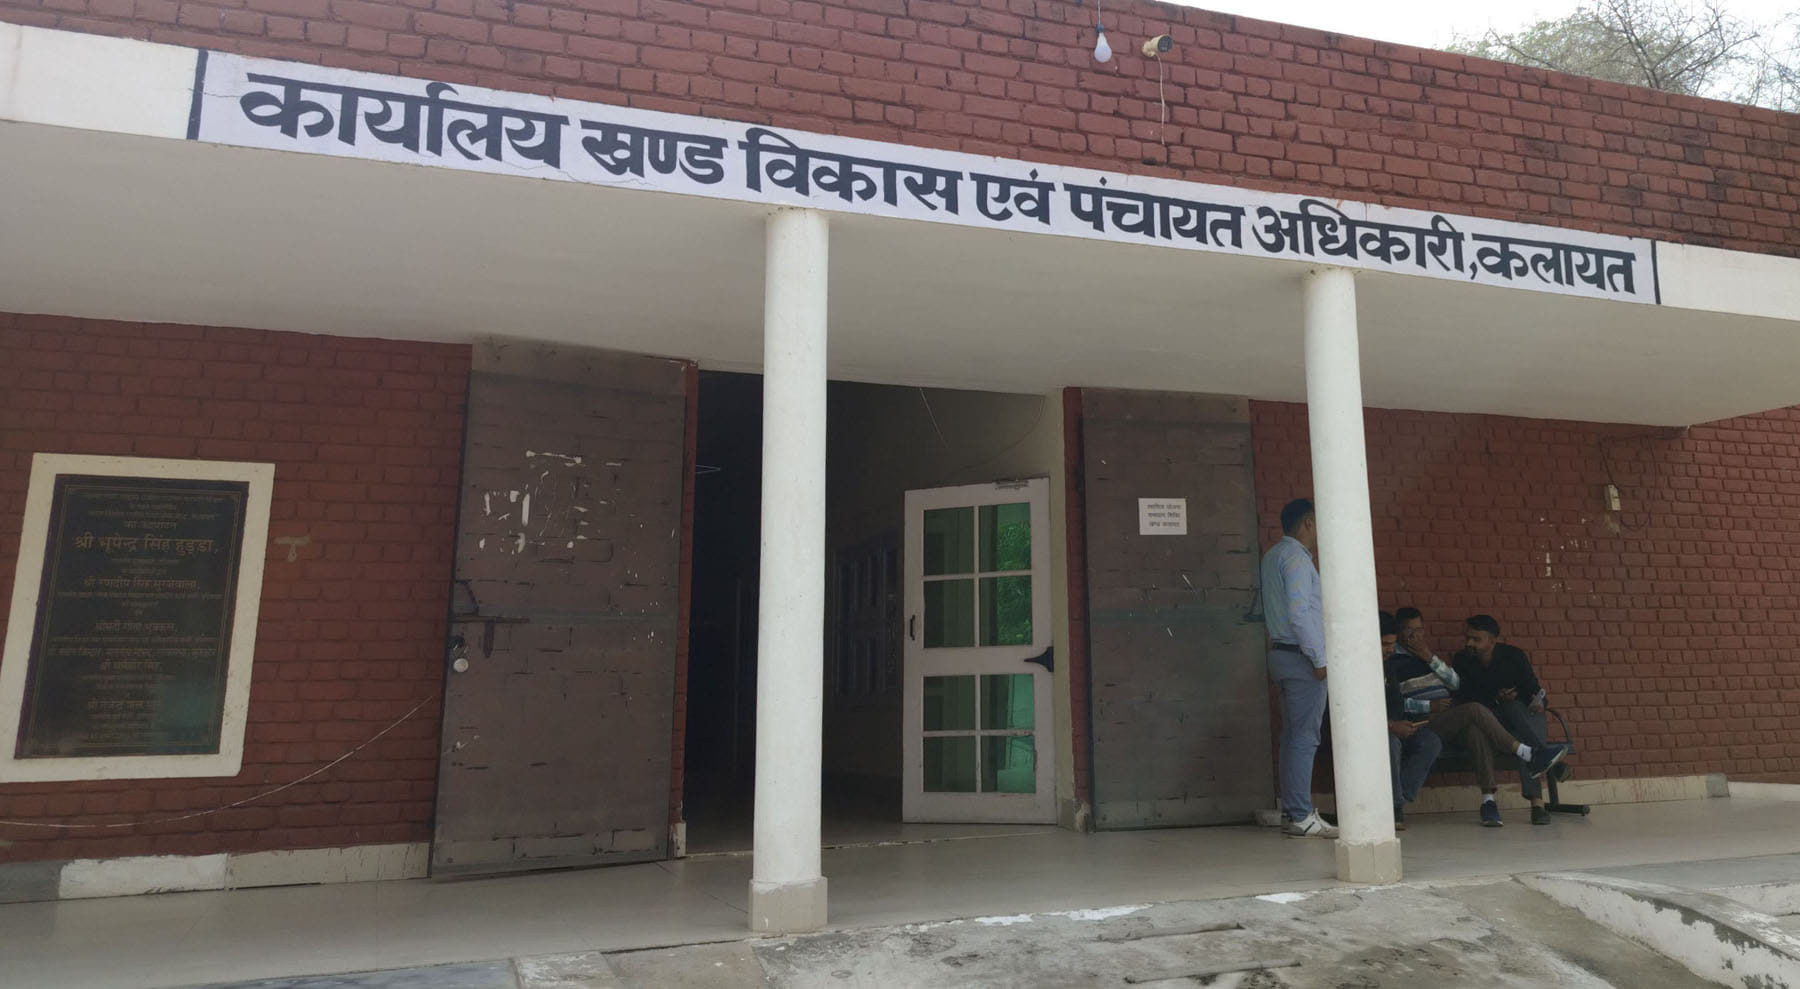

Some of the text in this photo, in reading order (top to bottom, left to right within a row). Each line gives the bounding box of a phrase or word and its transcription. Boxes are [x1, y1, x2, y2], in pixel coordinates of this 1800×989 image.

[240, 73, 570, 169] कार्यालय
[580, 119, 729, 185] खण्ड
[738, 127, 963, 215] विकास
[970, 168, 1056, 225] एवं
[1063, 176, 1246, 249] पंचायत
[75, 532, 95, 549] श्री
[143, 534, 171, 551] सिंह
